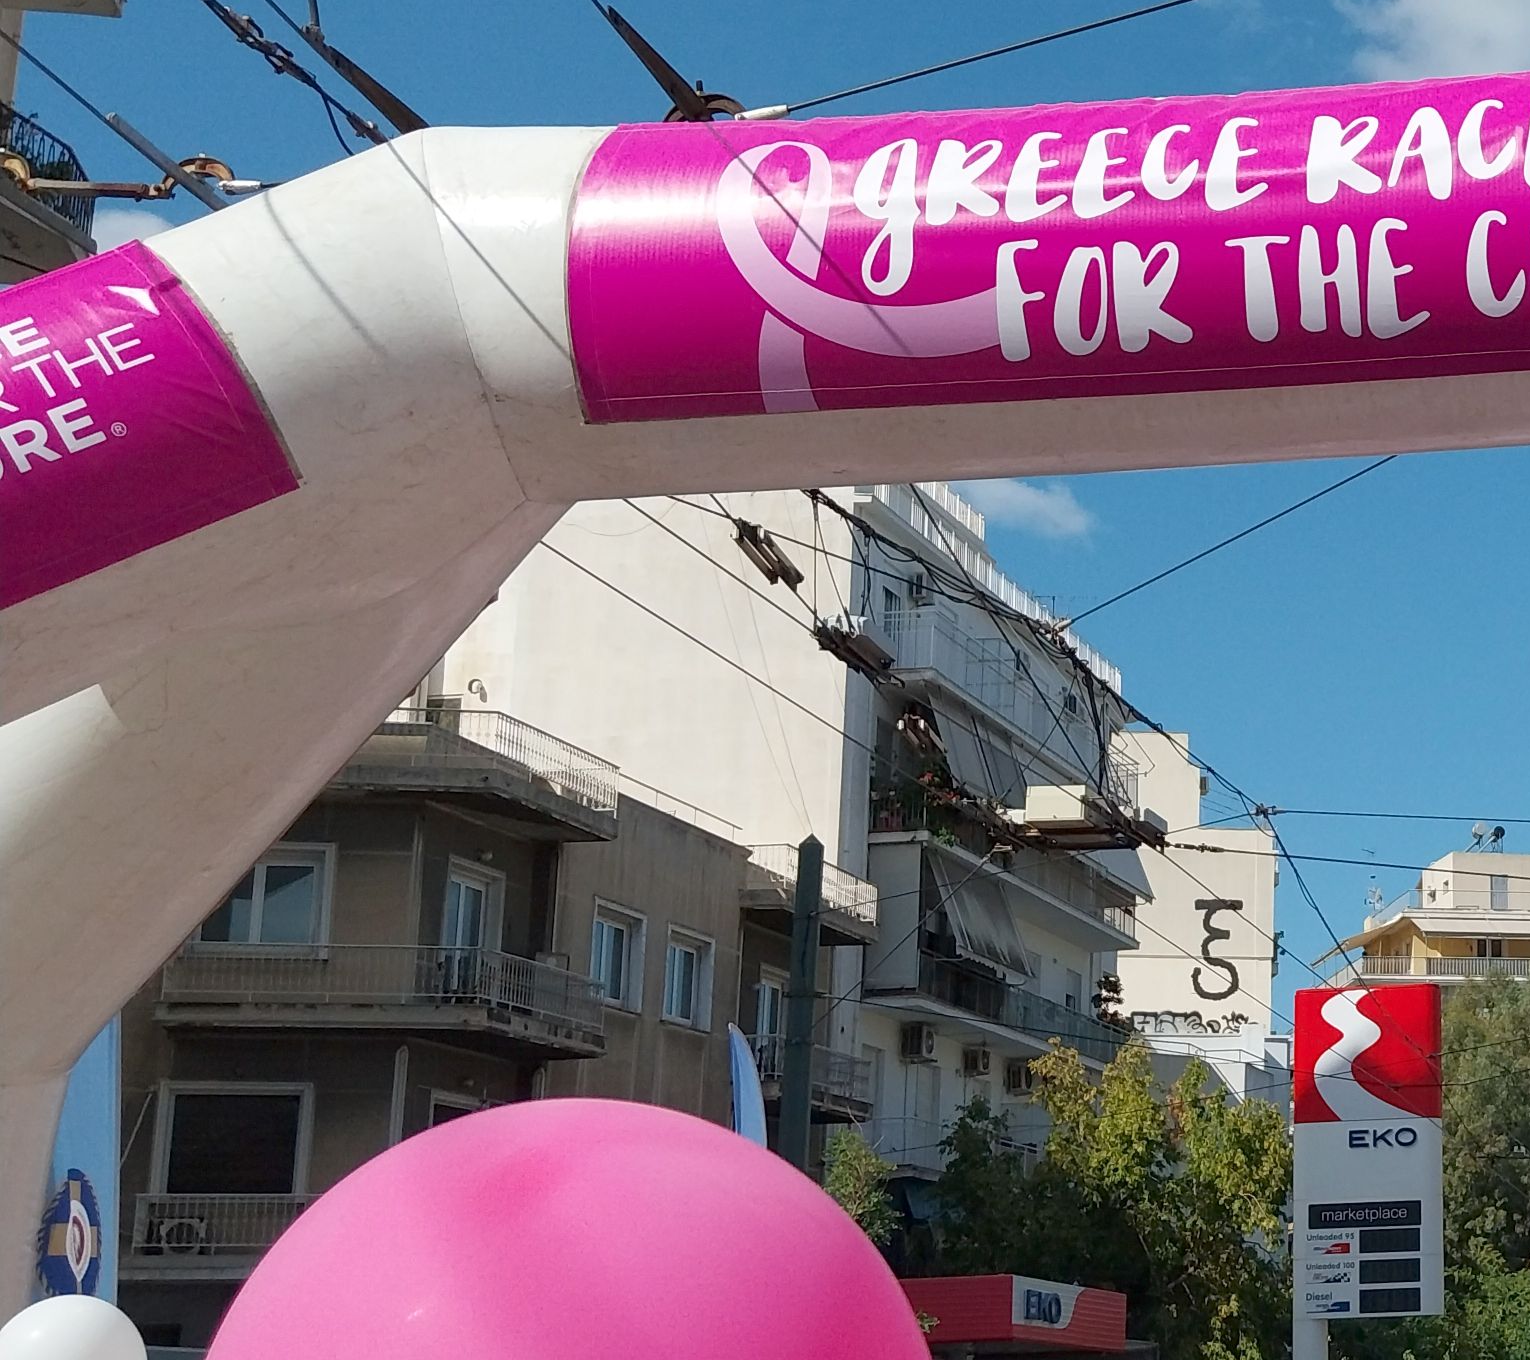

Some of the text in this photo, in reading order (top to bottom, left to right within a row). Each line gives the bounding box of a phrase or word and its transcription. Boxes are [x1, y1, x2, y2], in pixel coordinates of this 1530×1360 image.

[1000, 236, 1193, 362] FOR
[1226, 219, 1430, 341] THE
[12, 322, 155, 399] THE
[1349, 1127, 1417, 1148] EKO
[1321, 1207, 1407, 1222] marketplace
[1306, 1233, 1342, 1241] Unleaded
[1306, 1262, 1340, 1270] Unleaded
[1306, 1292, 1332, 1301] Diesel
[1025, 1289, 1062, 1324] EKO
